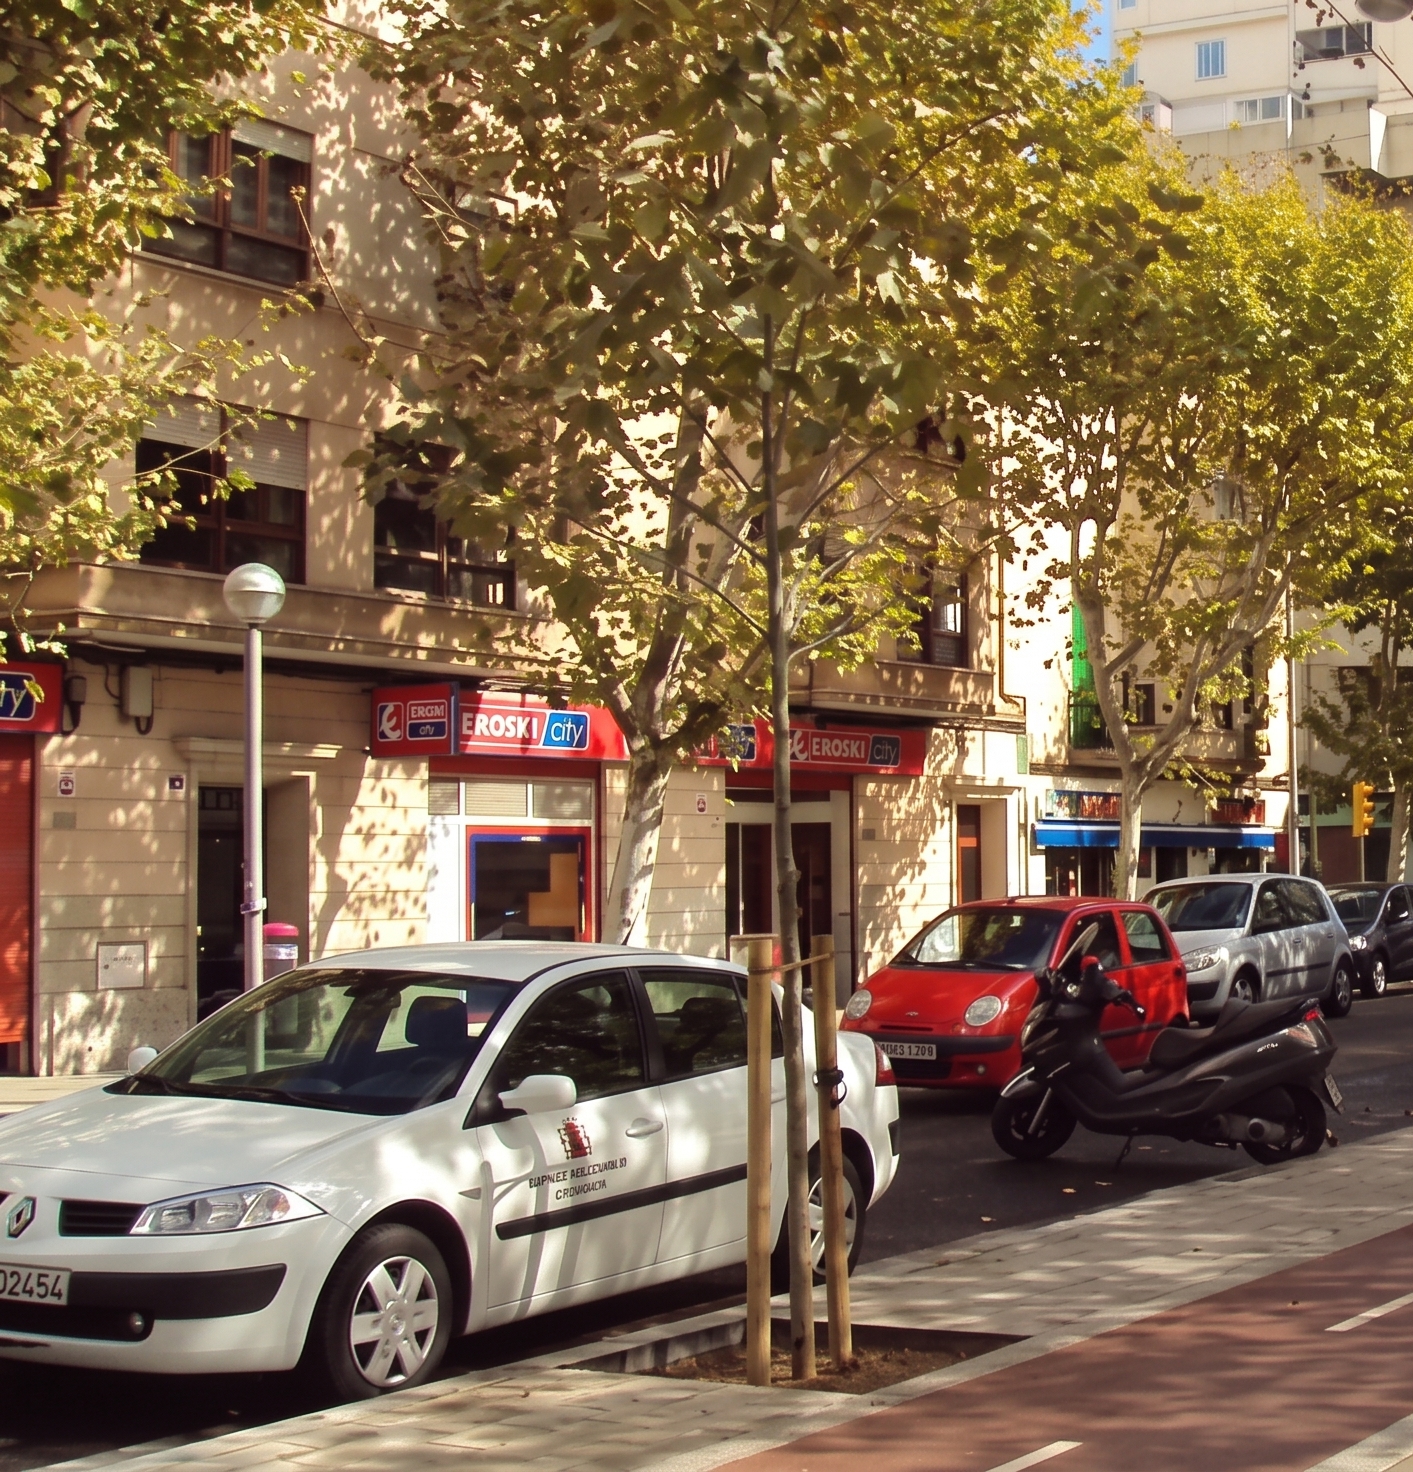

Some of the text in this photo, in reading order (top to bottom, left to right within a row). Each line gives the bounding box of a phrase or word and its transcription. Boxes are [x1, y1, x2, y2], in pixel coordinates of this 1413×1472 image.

[462, 711, 584, 747] EROSKI city
[812, 737, 898, 766] EROSKI city
